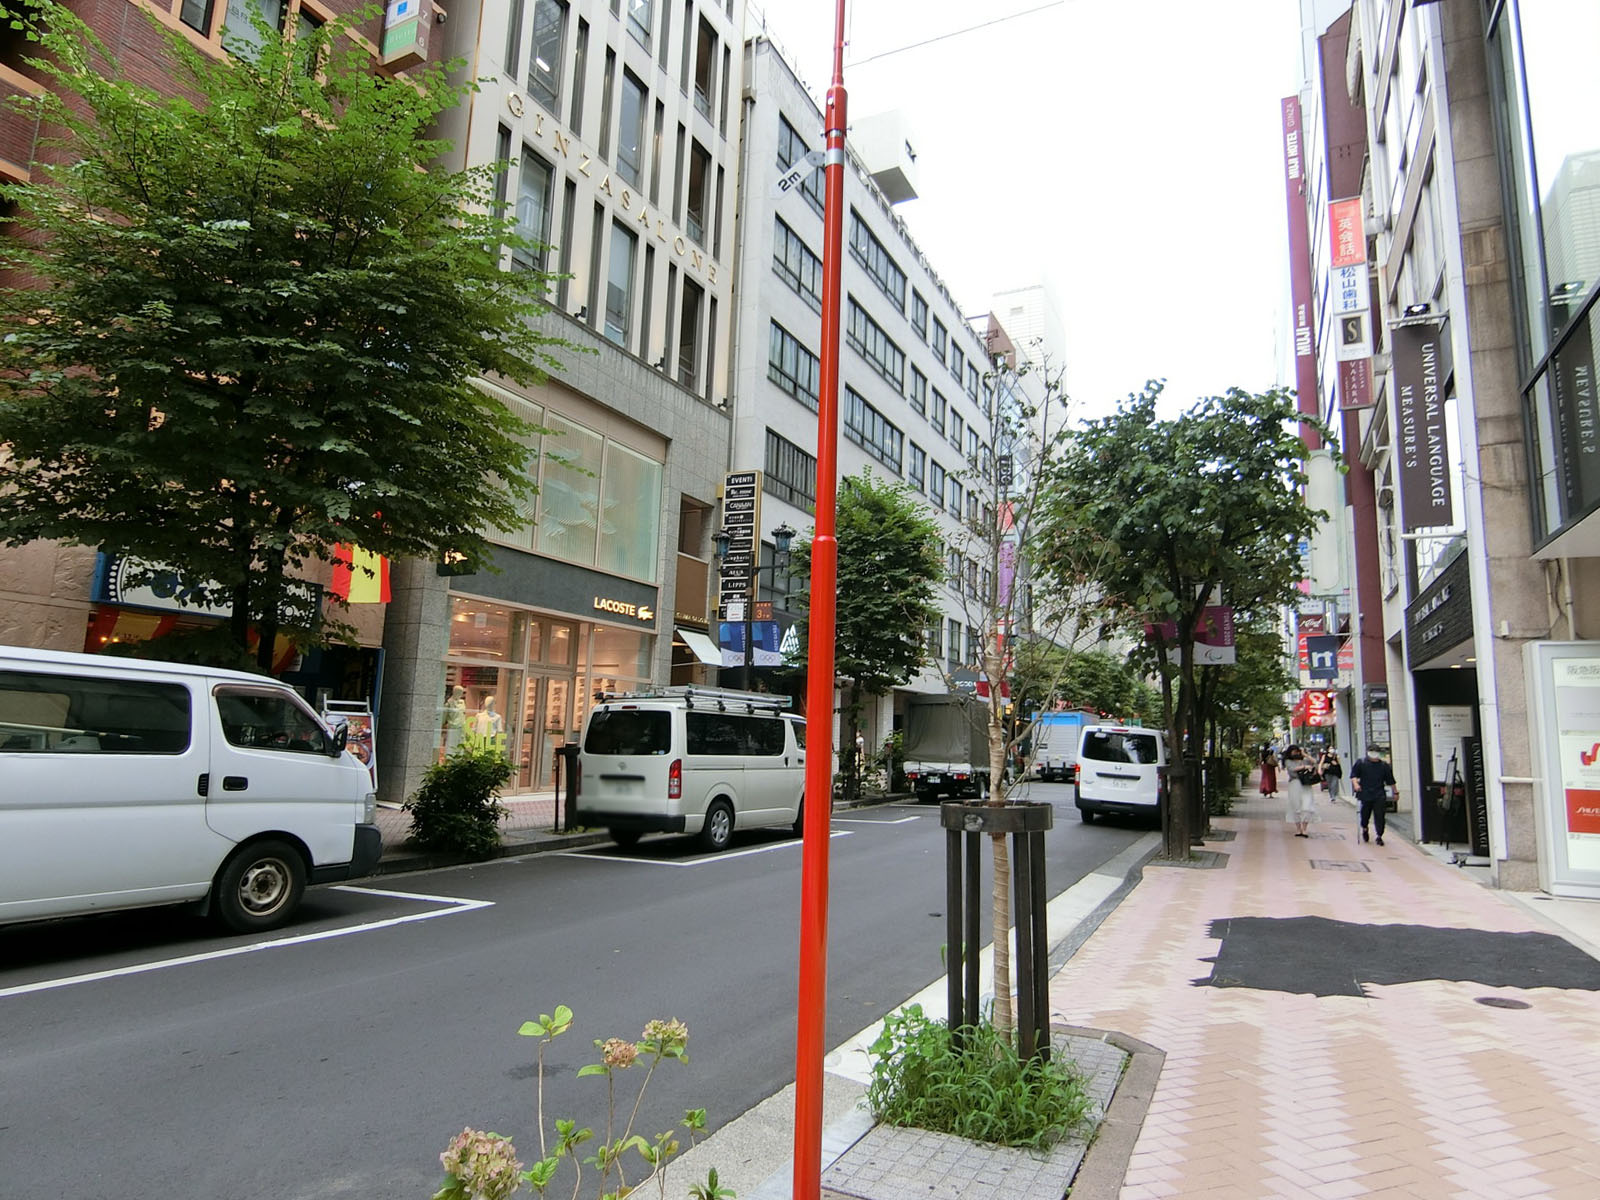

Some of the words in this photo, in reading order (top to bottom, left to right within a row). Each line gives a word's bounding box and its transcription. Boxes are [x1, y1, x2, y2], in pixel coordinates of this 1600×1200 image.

[778, 171, 801, 192] 2m
[1341, 266, 1358, 310] 松山歯科
[1295, 326, 1311, 356] MUJI
[1347, 320, 1358, 342] S
[1421, 343, 1440, 423] UNIVERSAL
[1400, 385, 1418, 468] MEASURE'S
[1425, 424, 1446, 508] LANGUAGE
[593, 596, 636, 616] LACOSTE
[463, 716, 507, 763] SALE
[1471, 742, 1483, 793] UNIVERSAL
[1475, 795, 1488, 848] LANGUAGE
